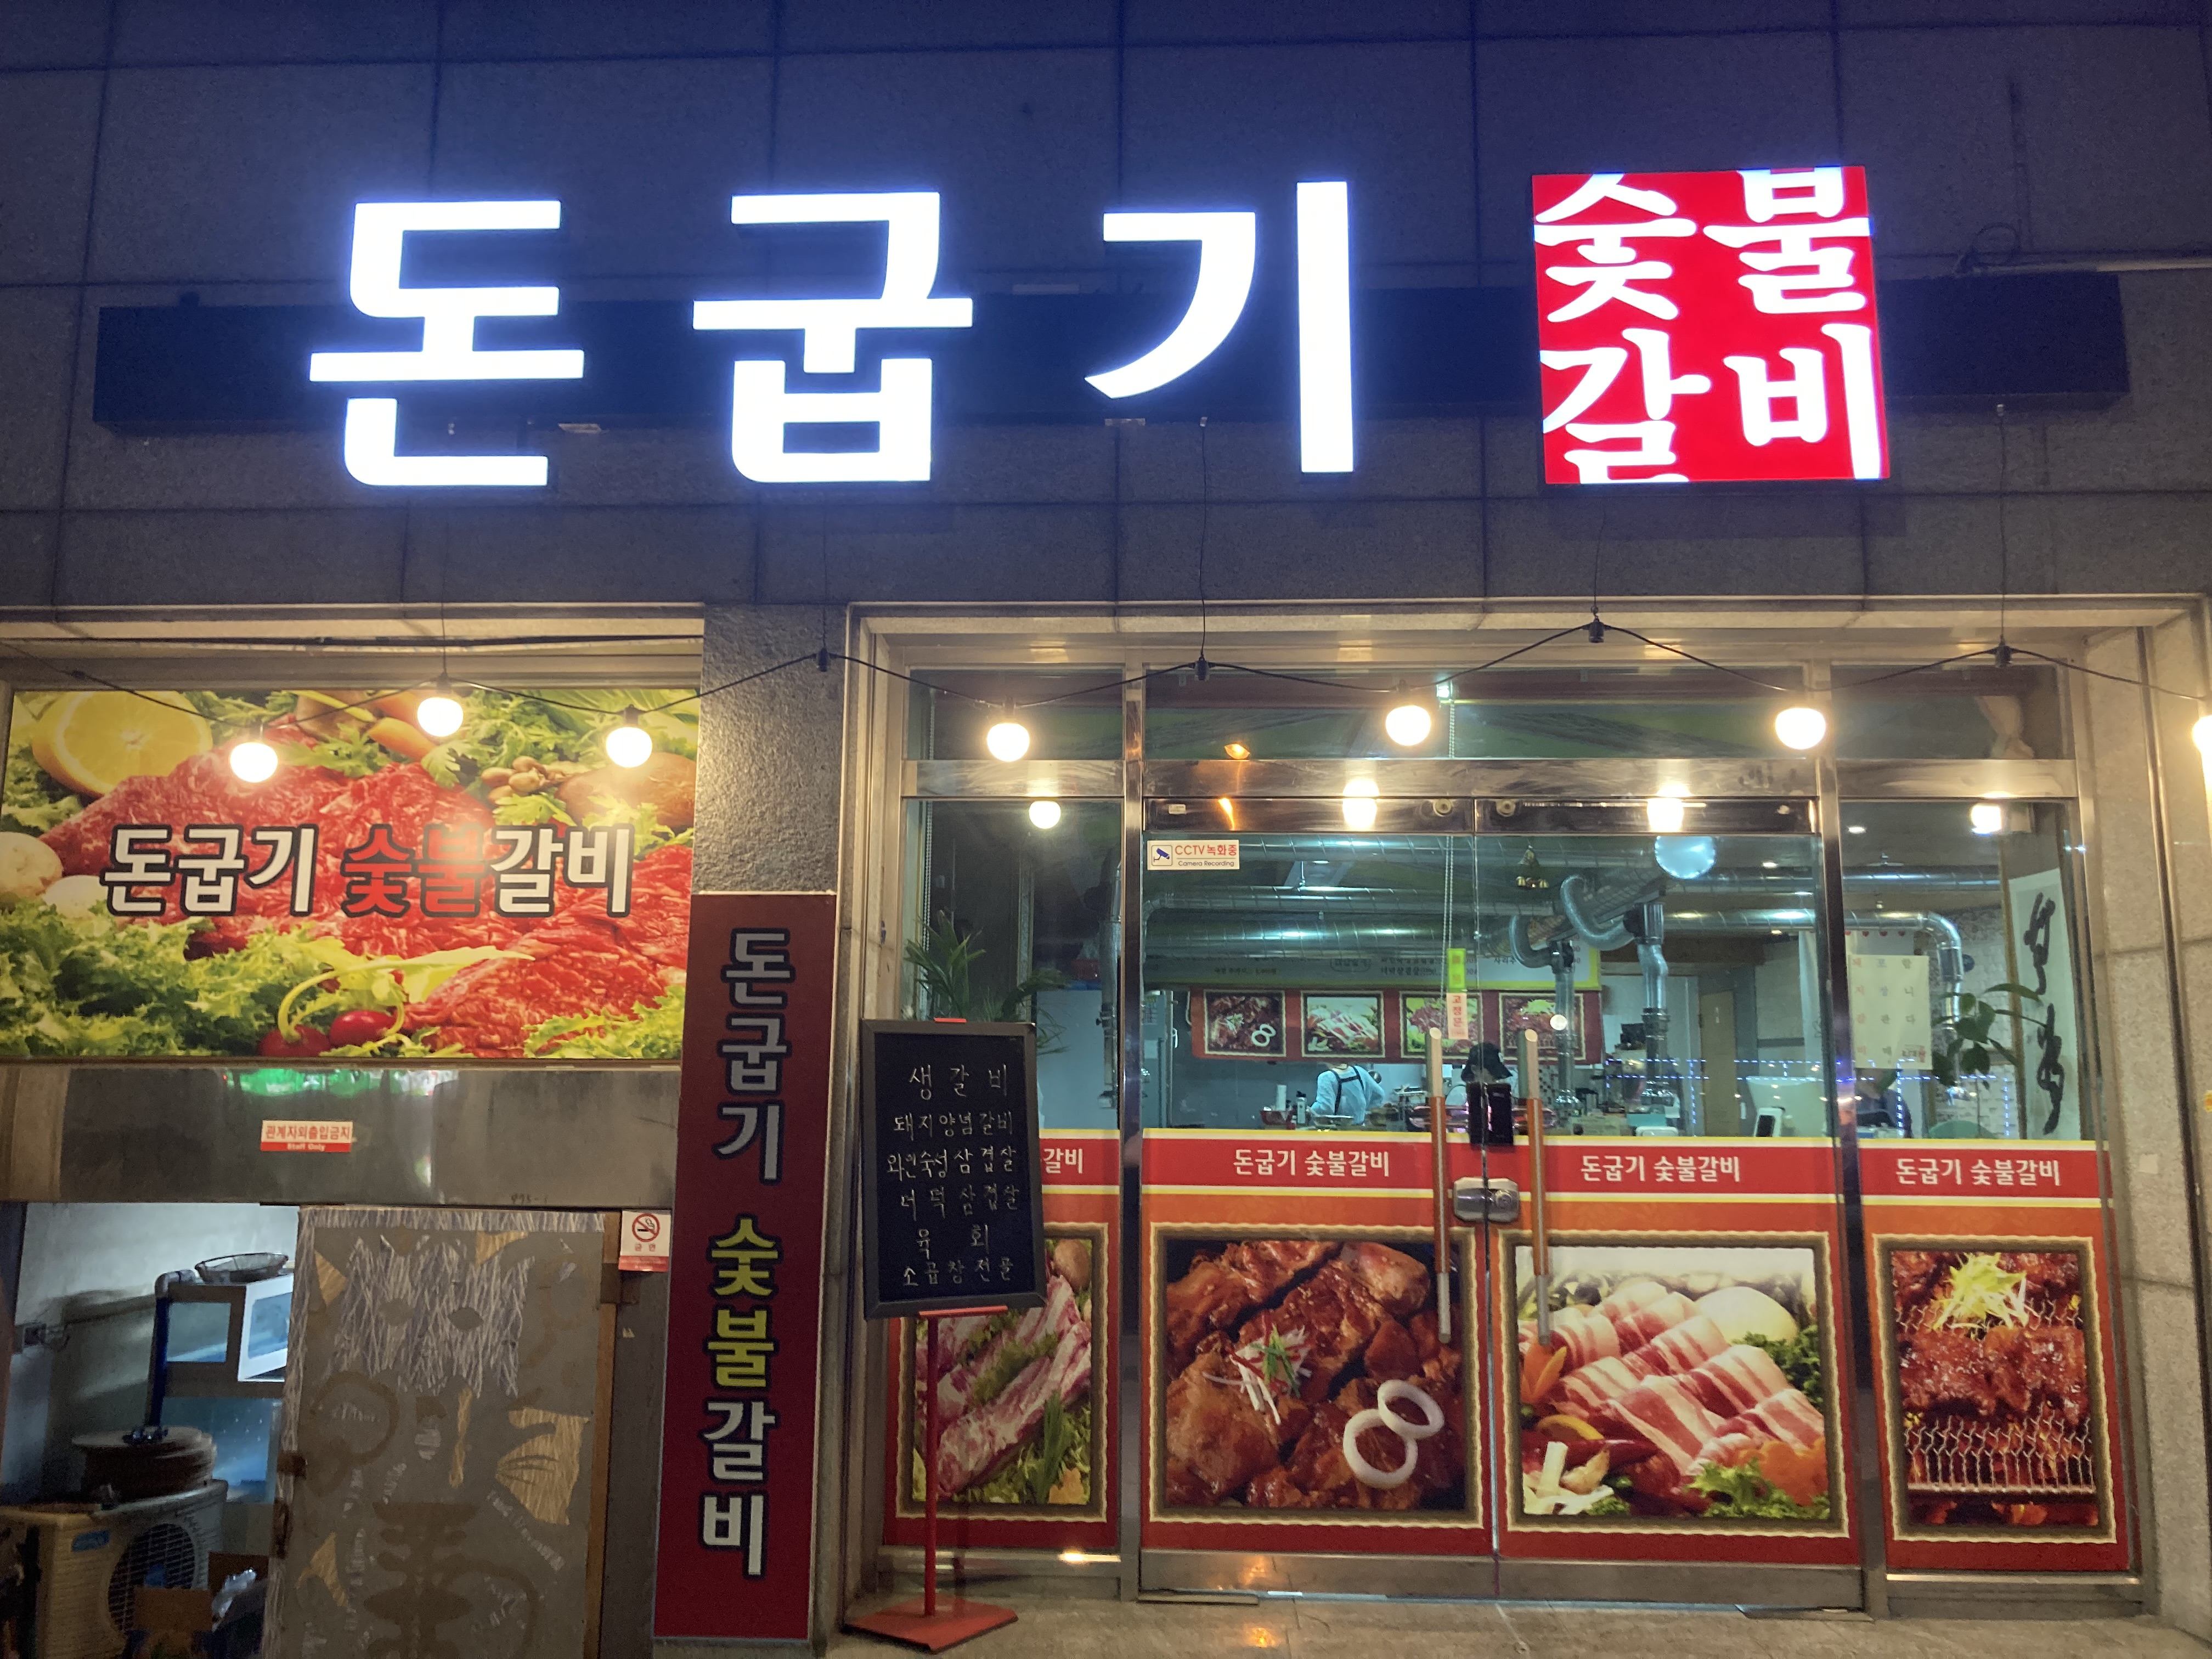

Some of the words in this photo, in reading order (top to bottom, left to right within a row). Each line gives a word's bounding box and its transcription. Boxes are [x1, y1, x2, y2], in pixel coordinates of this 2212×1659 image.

[1533, 166, 1871, 323] 숯불
[308, 180, 1355, 487] 돈굽기
[1539, 323, 1882, 484] 갈비
[104, 823, 318, 917] 돈굽기
[341, 823, 635, 918] 숯불갈비
[1175, 845, 1205, 855] CCTV
[1207, 844, 1237, 856] 녹화중
[714, 929, 792, 1181] 돈굽기
[1043, 1148, 1084, 1174] 갈비
[1233, 1149, 1296, 1176] 돈굽기
[1304, 1150, 1390, 1177] 숯불갈비
[1580, 1155, 1646, 1182] 돈굽기
[1654, 1155, 1741, 1183] 숯불갈비
[1895, 1158, 1962, 1186] 돈굽기
[1970, 1158, 2062, 1186] 숯불갈비
[701, 1217, 778, 1576] 숯불갈비
